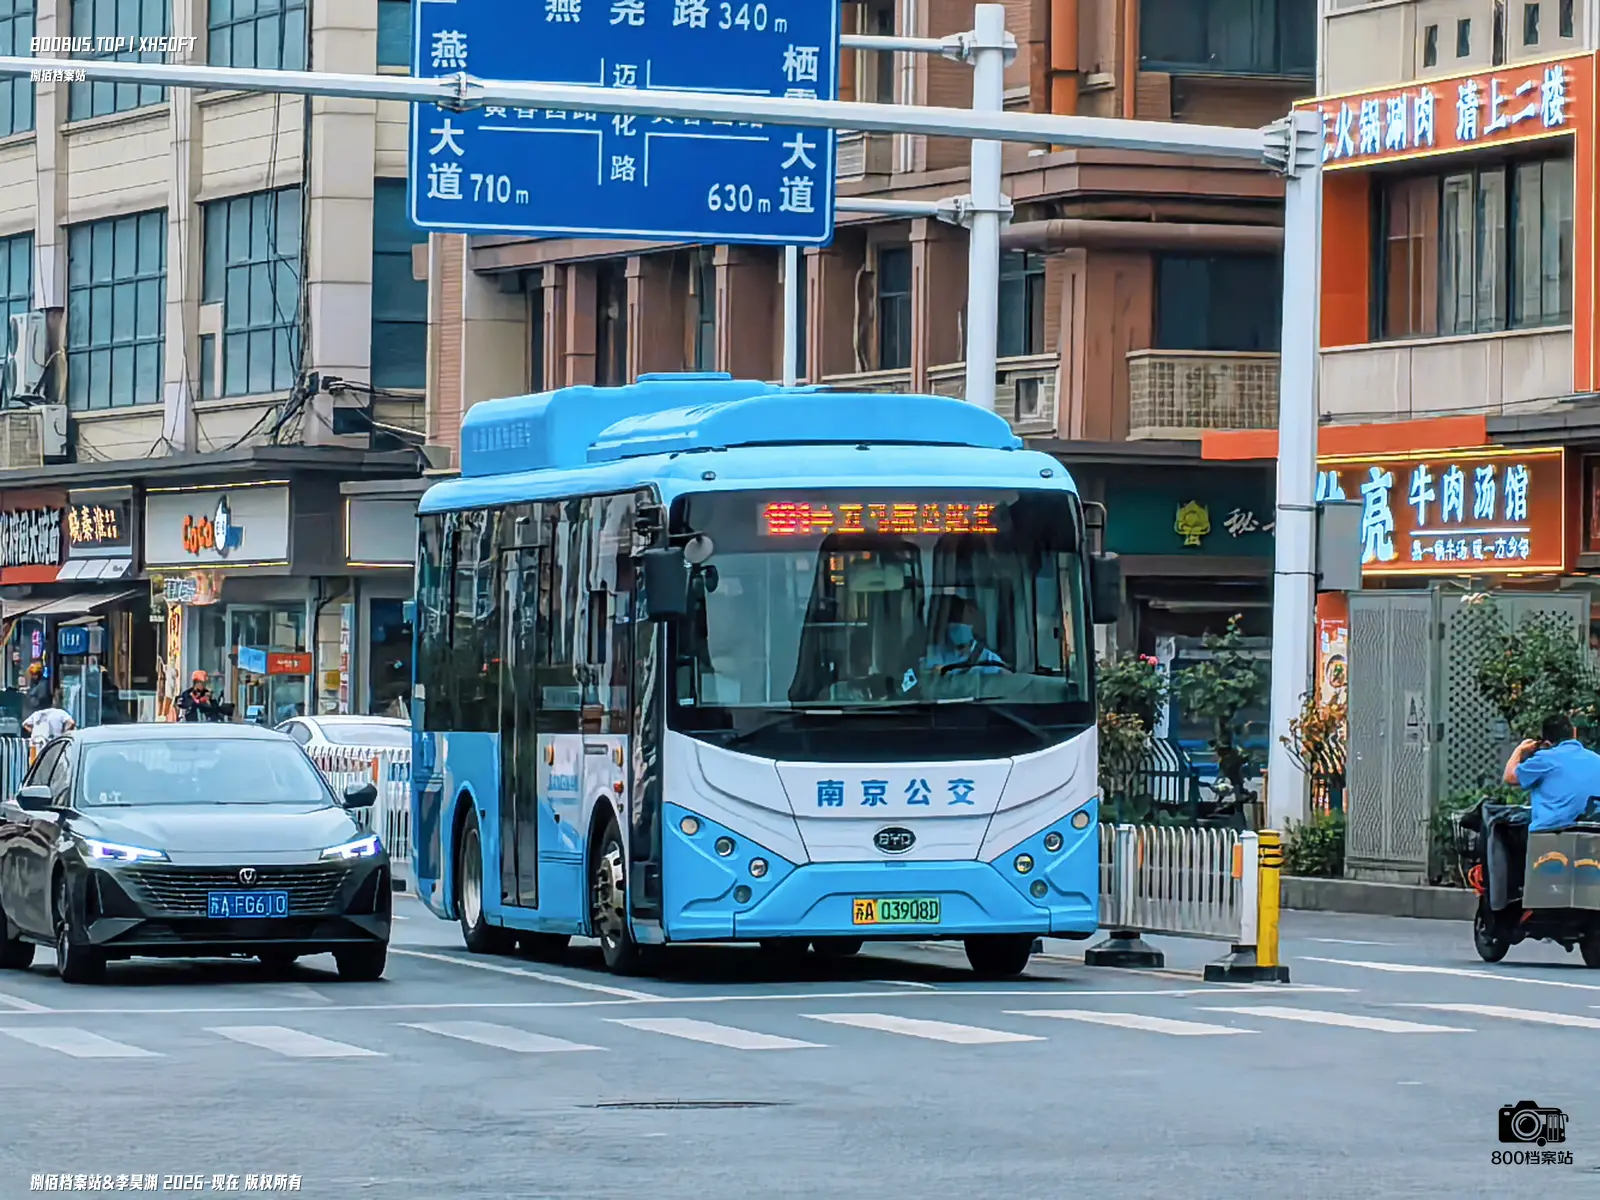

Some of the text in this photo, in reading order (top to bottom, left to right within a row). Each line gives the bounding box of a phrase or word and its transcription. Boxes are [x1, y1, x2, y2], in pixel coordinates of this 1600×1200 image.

[427, 30, 468, 200] 燕大道
[1318, 86, 1436, 163] 火锅涮肉
[1408, 464, 1530, 526] 牛肉汤馆
[816, 778, 976, 807] 南京公交
[877, 832, 911, 846] BYD
